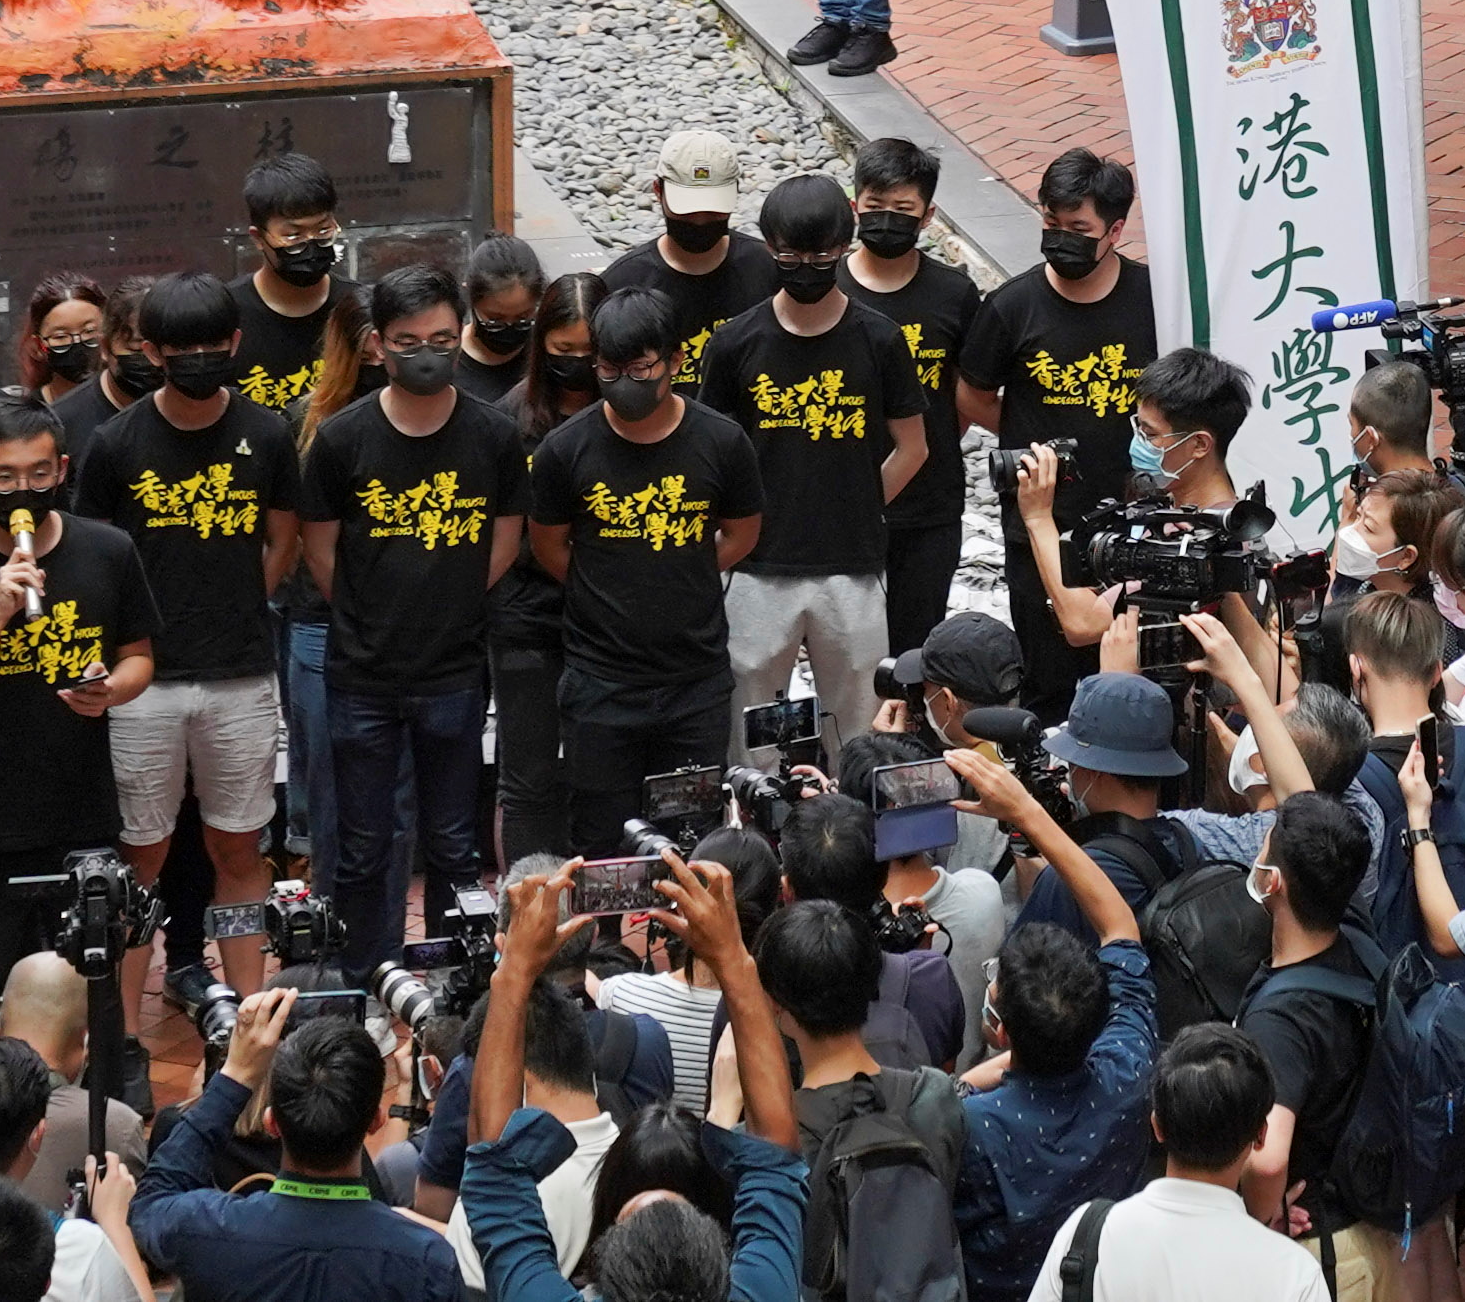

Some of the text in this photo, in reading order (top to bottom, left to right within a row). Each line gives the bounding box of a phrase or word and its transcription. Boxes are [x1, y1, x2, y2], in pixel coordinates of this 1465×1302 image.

[1349, 310, 1379, 326] AFP
[1025, 343, 1128, 396] 香港大學
[748, 369, 845, 419] 香港大學
[1086, 379, 1136, 418] 學生
[802, 404, 866, 441] 學生會
[129, 463, 234, 517] 香港大學
[355, 471, 459, 526] 香港大學
[582, 474, 687, 529] 香港大學
[190, 500, 259, 541] 學生會
[415, 509, 487, 551] 學生會
